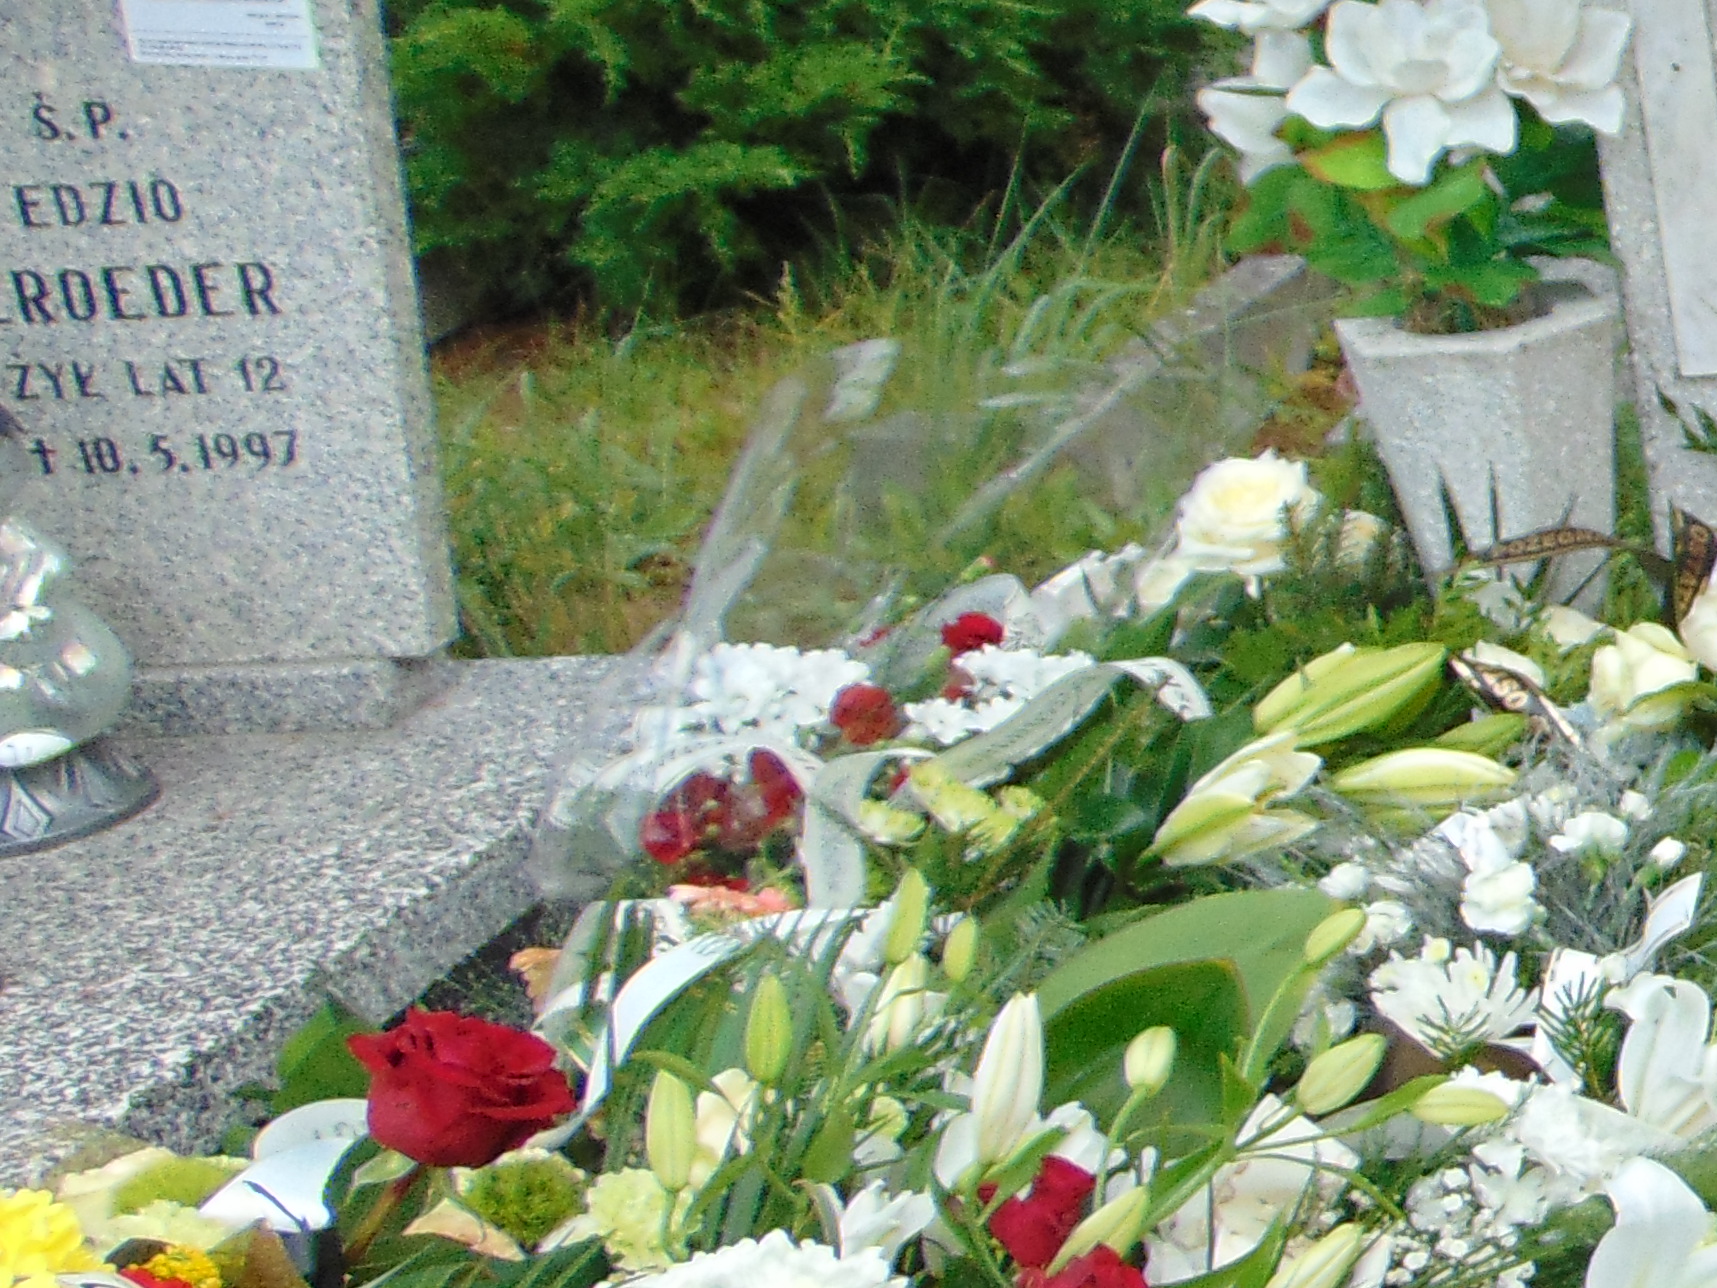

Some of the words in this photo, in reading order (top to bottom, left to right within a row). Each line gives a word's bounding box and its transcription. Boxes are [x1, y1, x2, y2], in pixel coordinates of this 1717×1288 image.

[12, 176, 185, 230] EDZIO
[0, 262, 285, 327] ROEDER
[123, 356, 211, 398] LAT
[234, 355, 288, 394] 12
